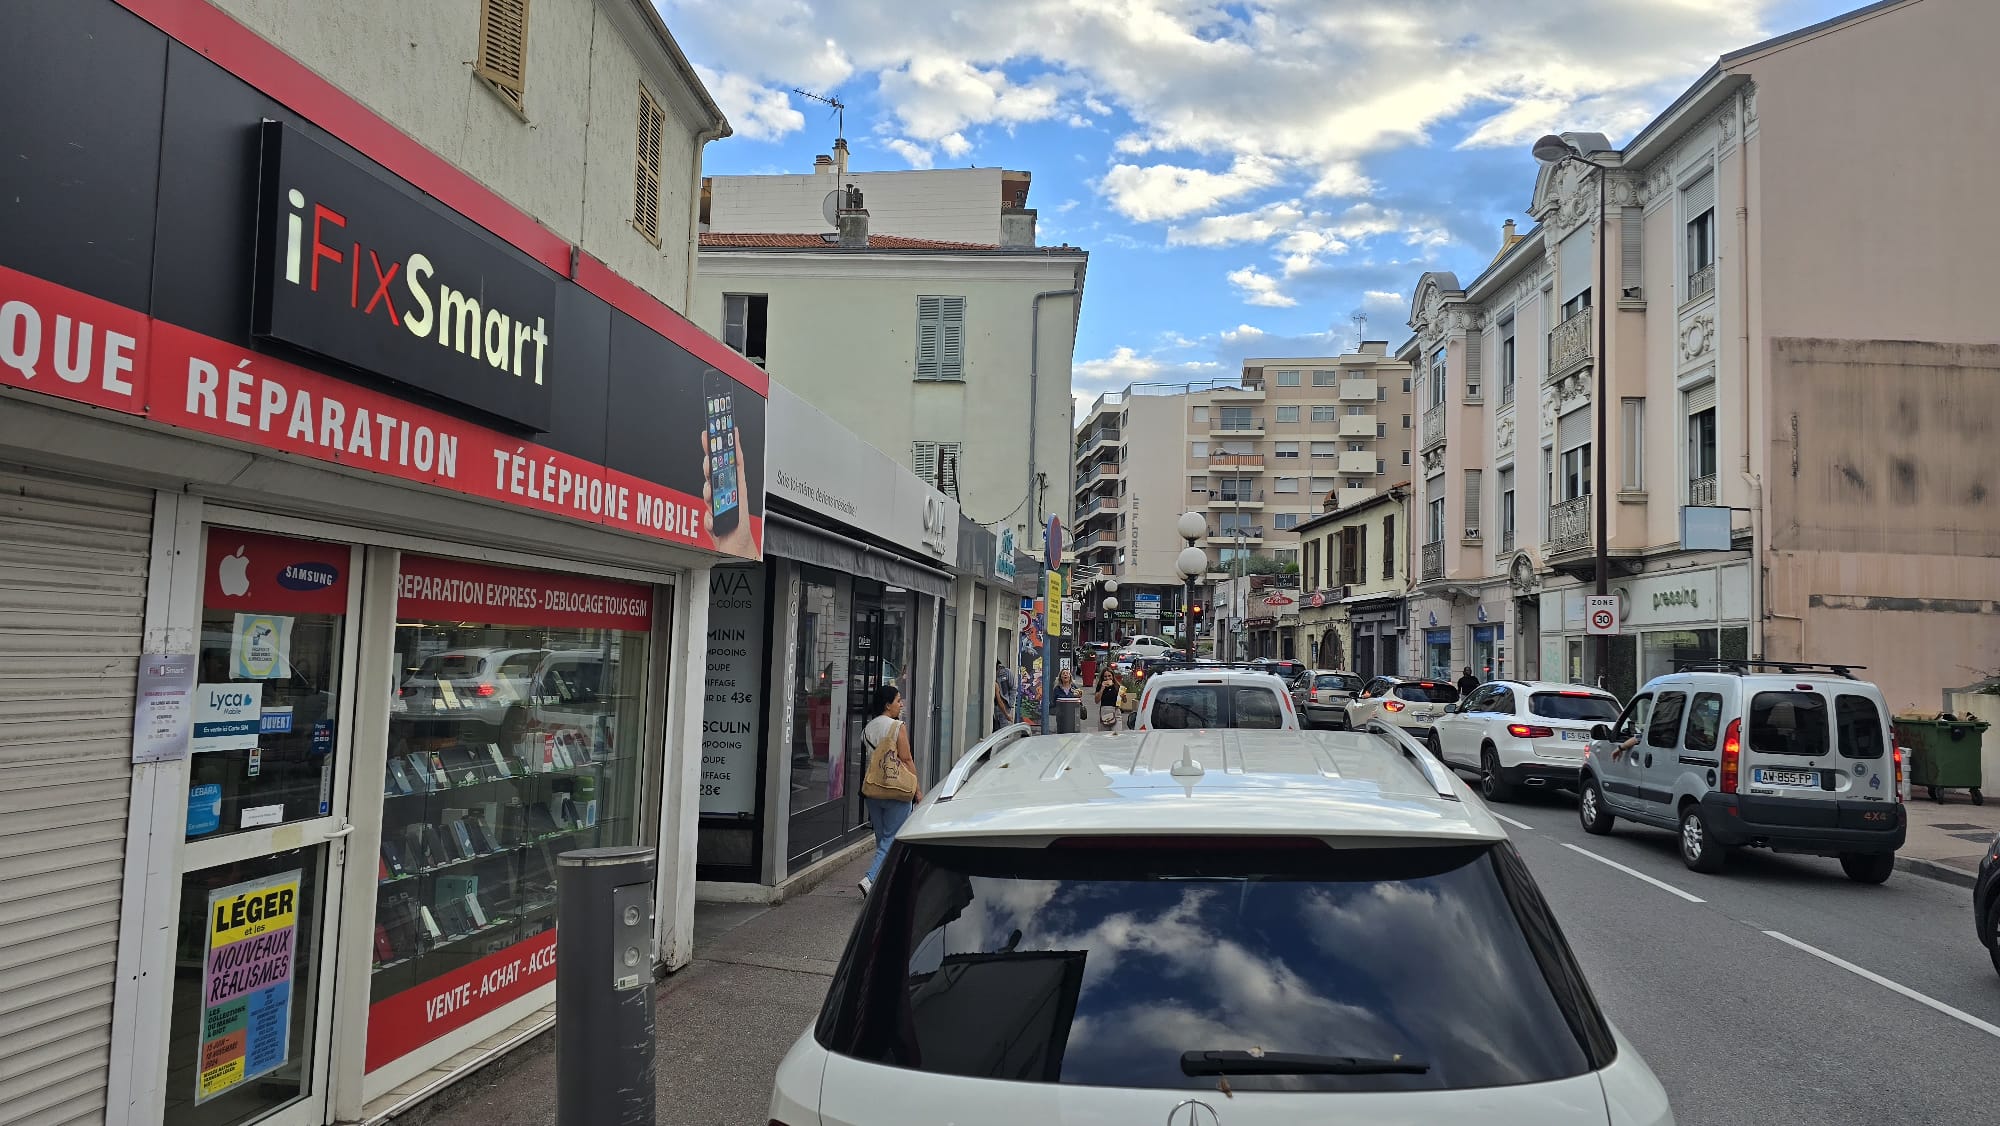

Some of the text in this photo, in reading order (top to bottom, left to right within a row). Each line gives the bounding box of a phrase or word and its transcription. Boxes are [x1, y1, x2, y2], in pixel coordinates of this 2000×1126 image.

[186, 358, 458, 478] RÉPARATION
[494, 447, 629, 521] TÉLÉPHONE
[636, 492, 699, 539] MOBILE
[286, 565, 333, 586] SAMSUNG
[487, 584, 536, 609] EXPRESS
[545, 590, 603, 614] DEBLOCAGE
[605, 596, 628, 616] TOUS
[629, 598, 647, 617] GSM
[1653, 586, 1699, 610] pressing
[1596, 615, 1610, 624] 30
[785, 580, 798, 744] COIFFURE
[210, 691, 242, 710] Lyca
[731, 692, 752, 703] 43€
[261, 716, 290, 730] OUVERT
[191, 786, 218, 797] LEBARA
[216, 889, 294, 932] LÉGER
[244, 924, 265, 936] et les
[212, 929, 291, 974] NOUVEAUX
[210, 955, 289, 1002] RÉALISMES
[426, 982, 471, 1023] VENTE
[480, 959, 521, 998] ACHAT
